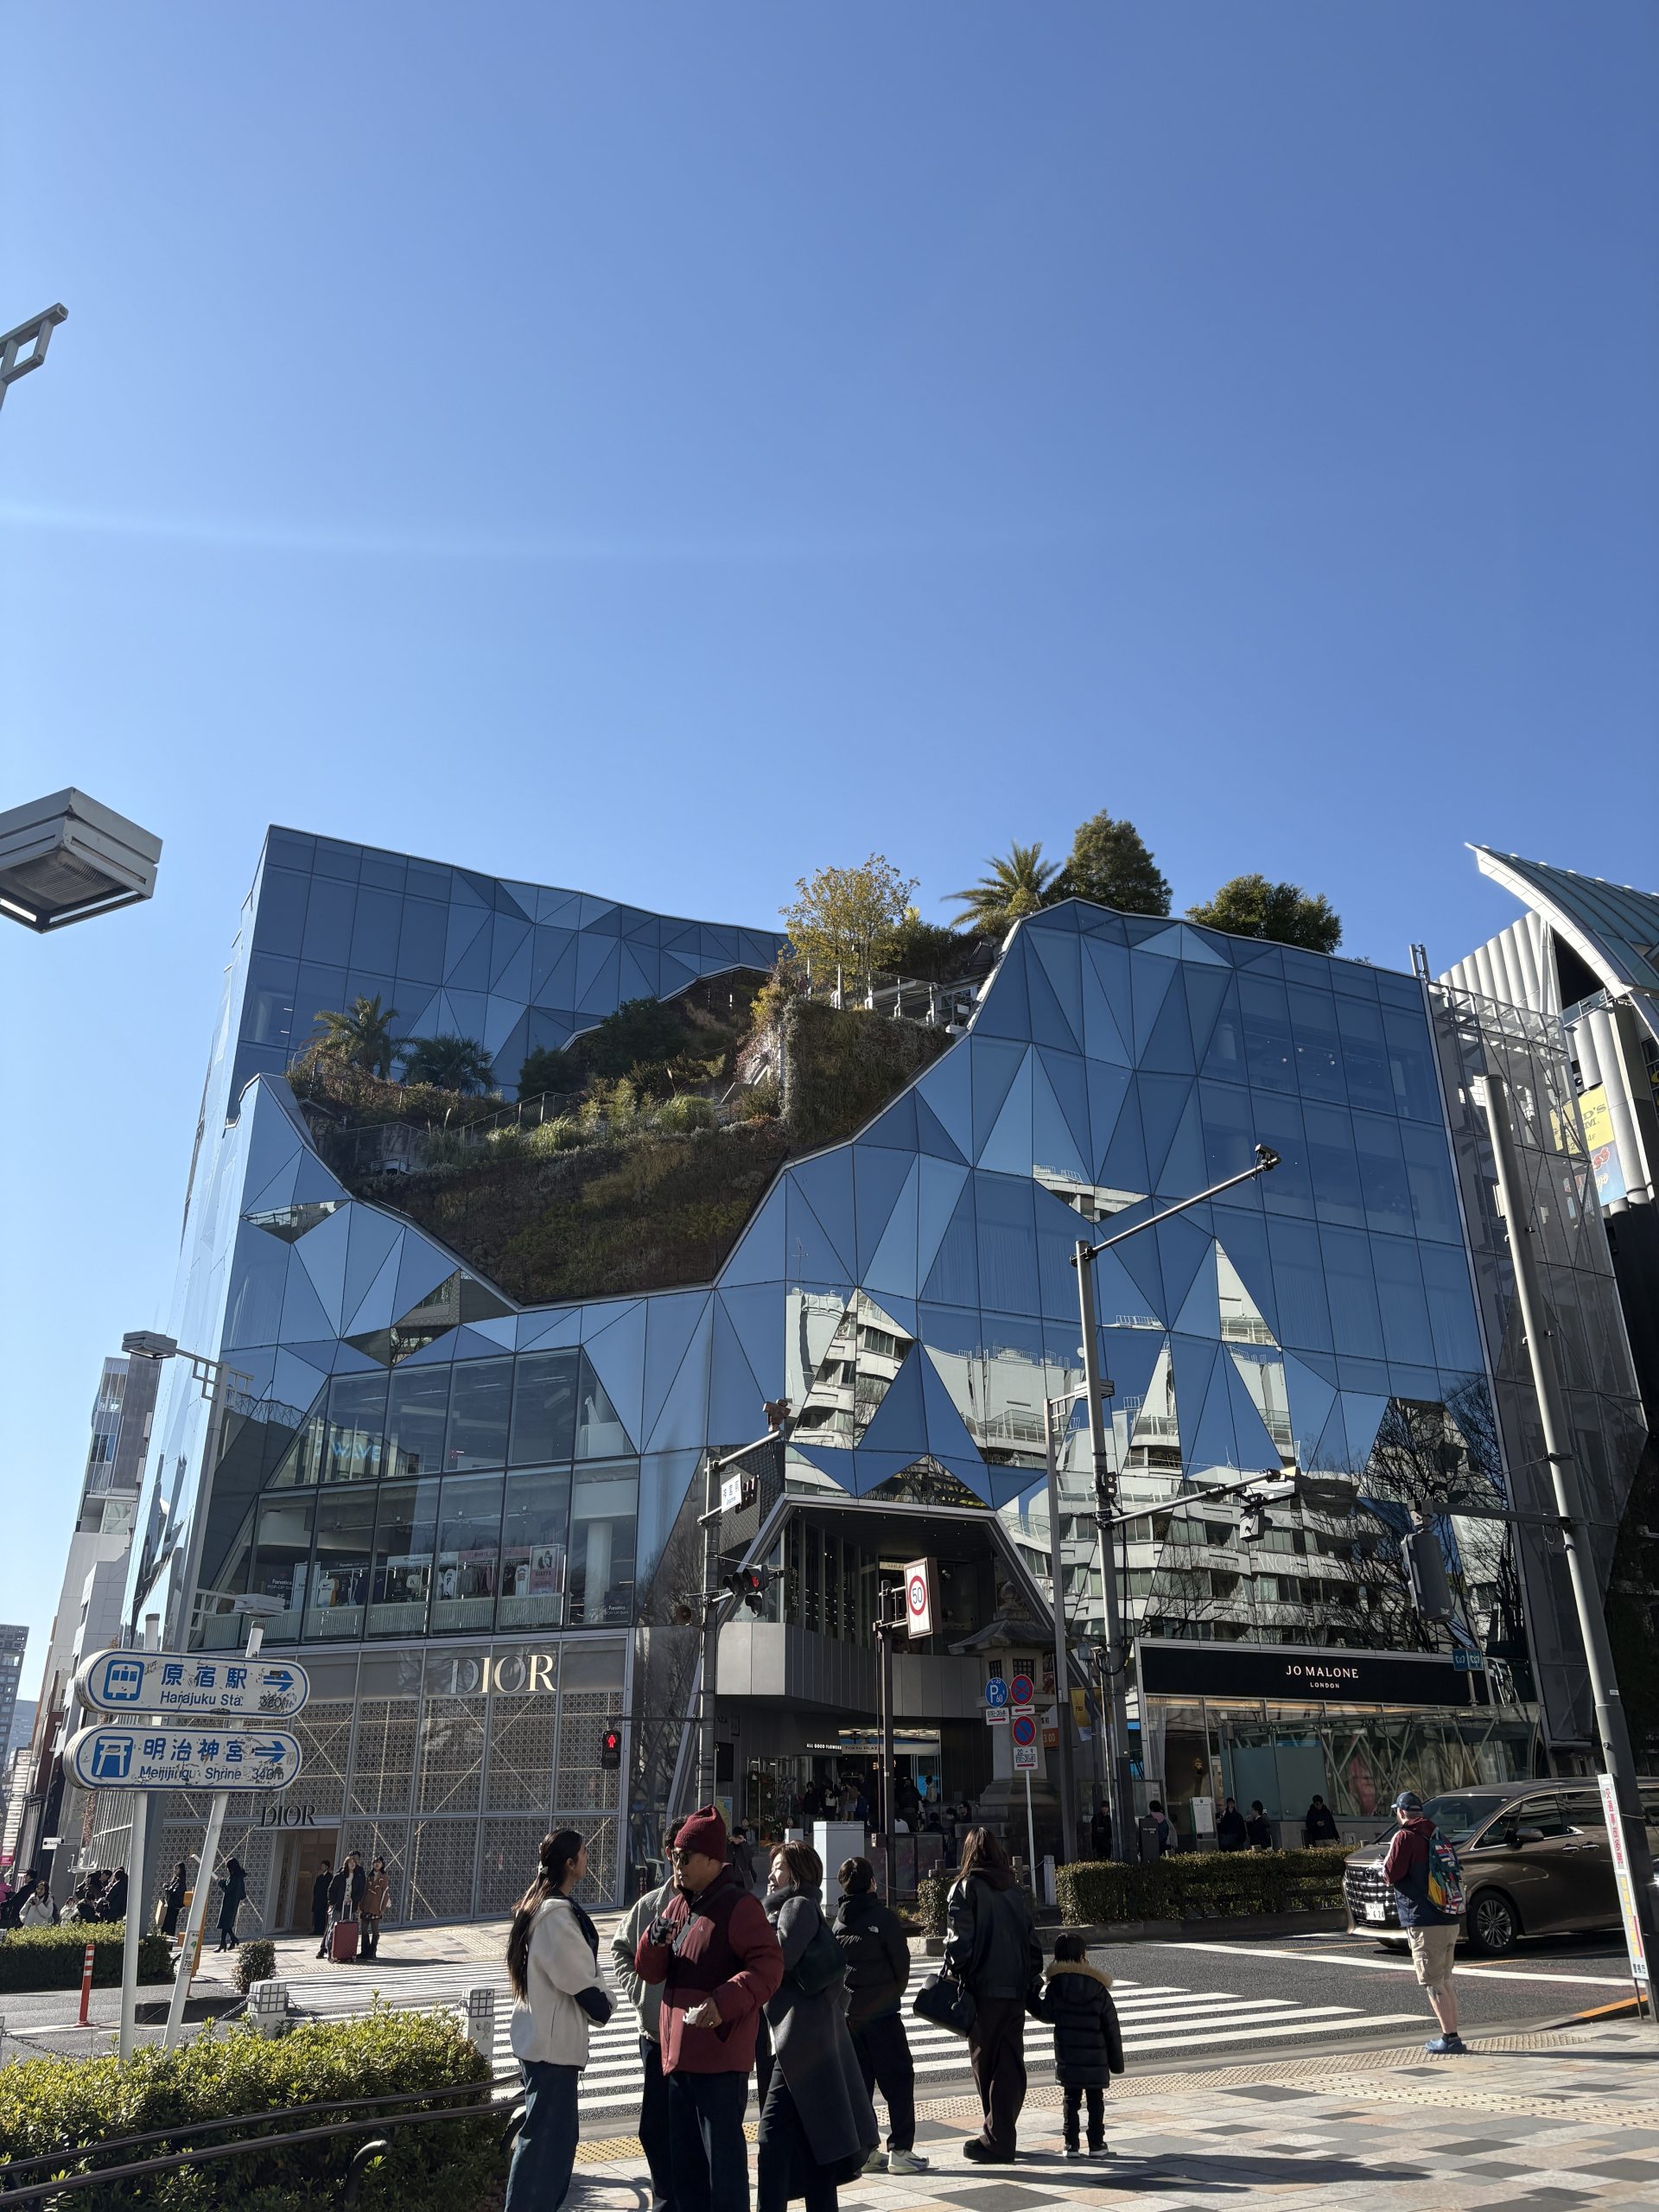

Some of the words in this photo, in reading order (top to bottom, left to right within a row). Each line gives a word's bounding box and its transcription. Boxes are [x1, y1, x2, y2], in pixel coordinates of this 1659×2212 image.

[912, 1586, 923, 1605] 50
[161, 1663, 248, 1689] 原宿駅
[450, 1655, 557, 1694] DIOR
[1286, 1665, 1302, 1675] JO
[1305, 1666, 1359, 1679] MALONE
[160, 1691, 216, 1707] Harajuku
[143, 1737, 244, 1763] 明治神宮
[205, 1767, 242, 1781] Shrine
[260, 1804, 317, 1827] DIOR
